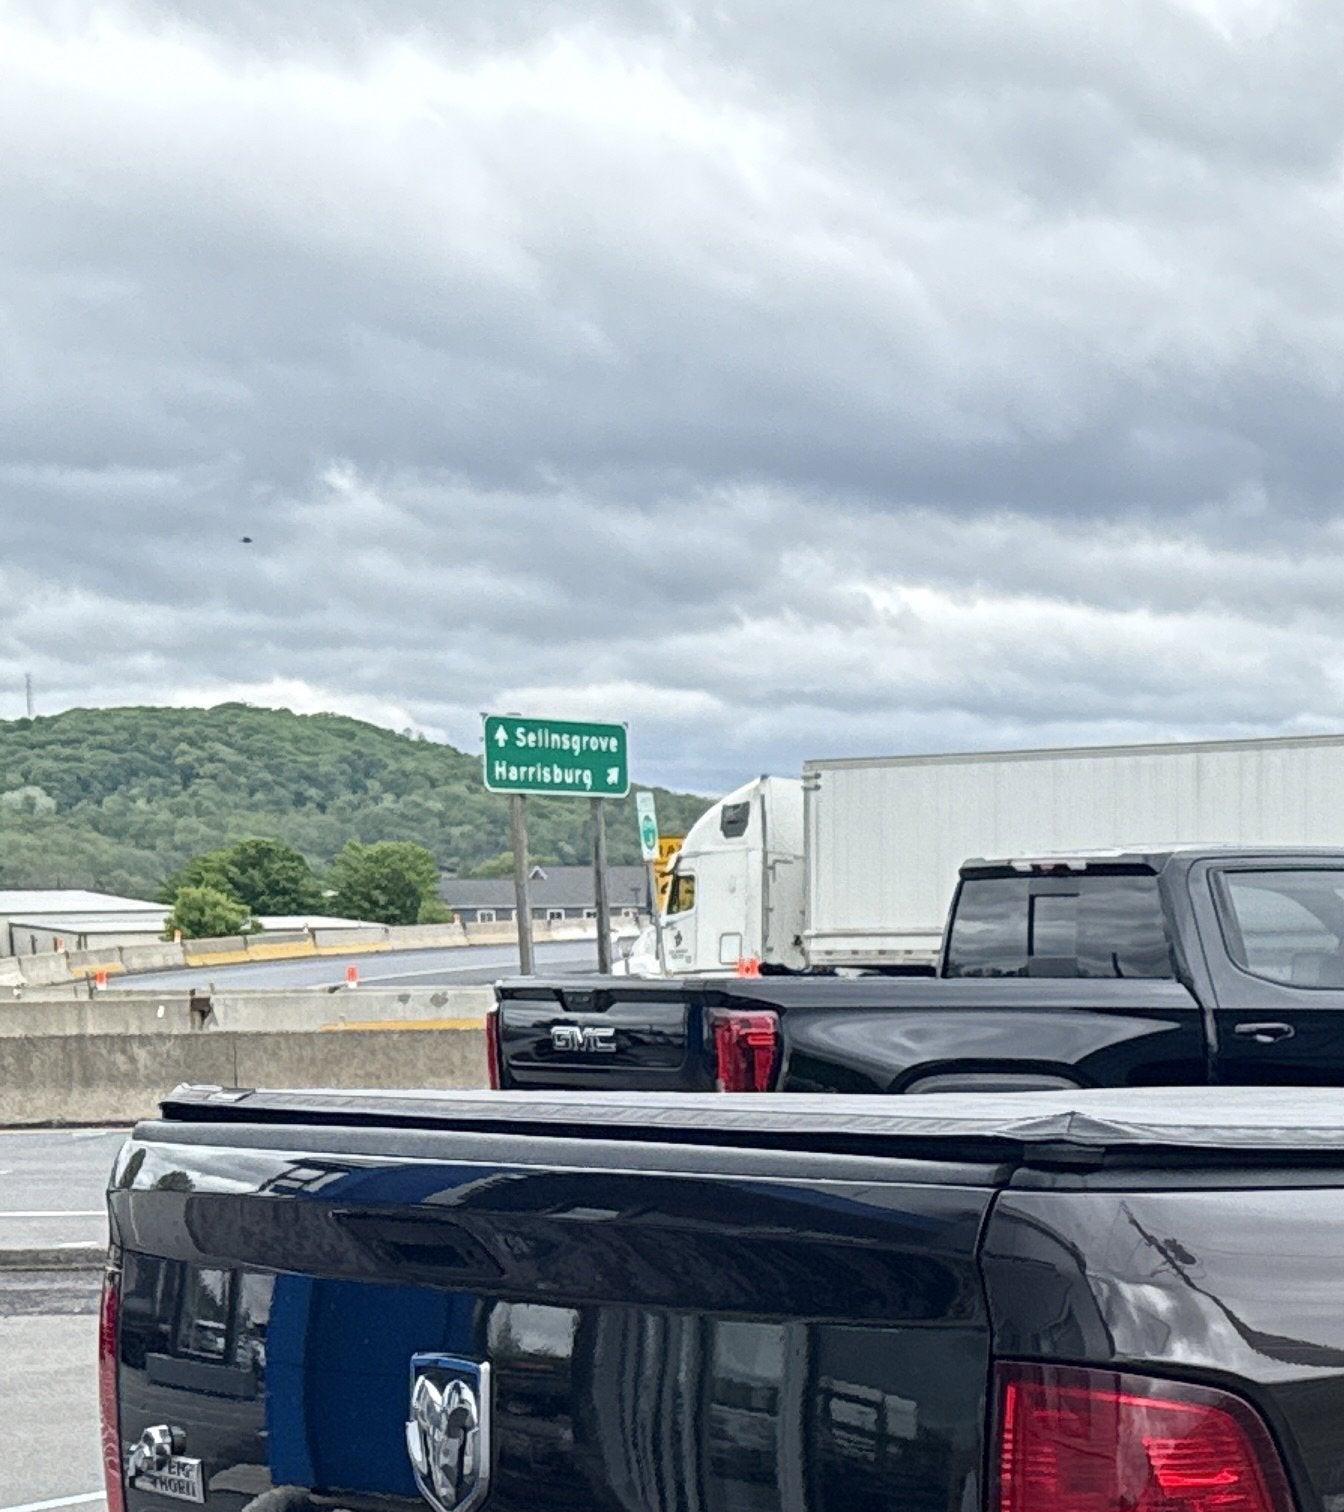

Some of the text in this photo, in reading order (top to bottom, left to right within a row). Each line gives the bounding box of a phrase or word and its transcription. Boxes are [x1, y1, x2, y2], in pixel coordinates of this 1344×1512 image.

[515, 727, 618, 757] Selinsgrove
[494, 760, 593, 791] Harrisburg
[551, 1026, 617, 1053] GMC
